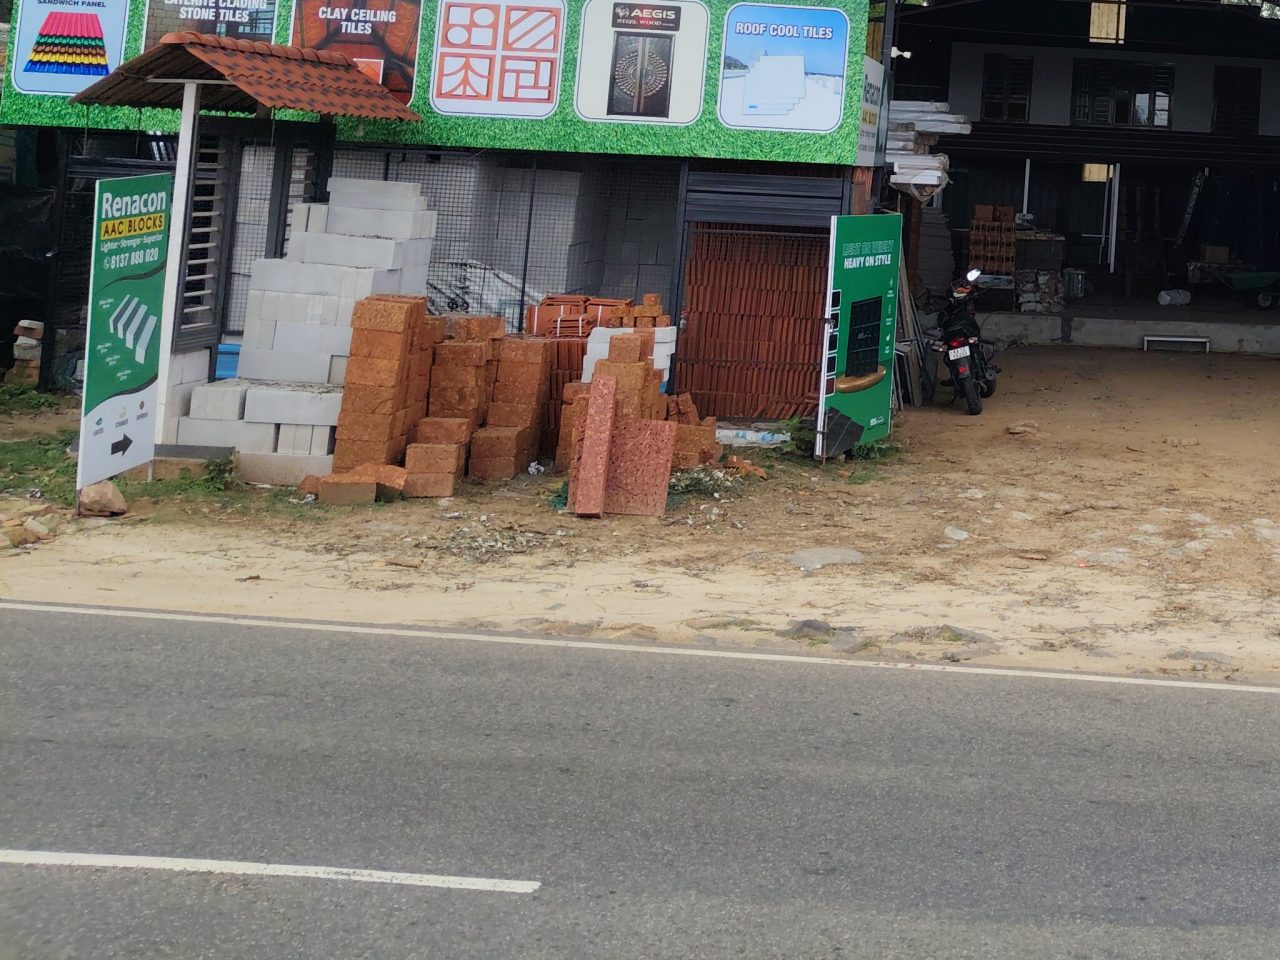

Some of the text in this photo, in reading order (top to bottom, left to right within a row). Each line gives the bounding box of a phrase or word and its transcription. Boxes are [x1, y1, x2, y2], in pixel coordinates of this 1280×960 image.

[81, 0, 106, 8] PANEL
[180, 6, 250, 22] STONE TILES
[318, 6, 396, 23] CLAY CEILING
[631, 8, 676, 19] AEGIS
[340, 21, 372, 35] TILES
[736, 21, 833, 40] ROOF COOL TILES
[101, 191, 167, 219] Renacon
[103, 214, 163, 238] AAC BLOCKS
[110, 247, 159, 269] 8137 888 020
[844, 254, 892, 270] HEAVY ON STYLE
